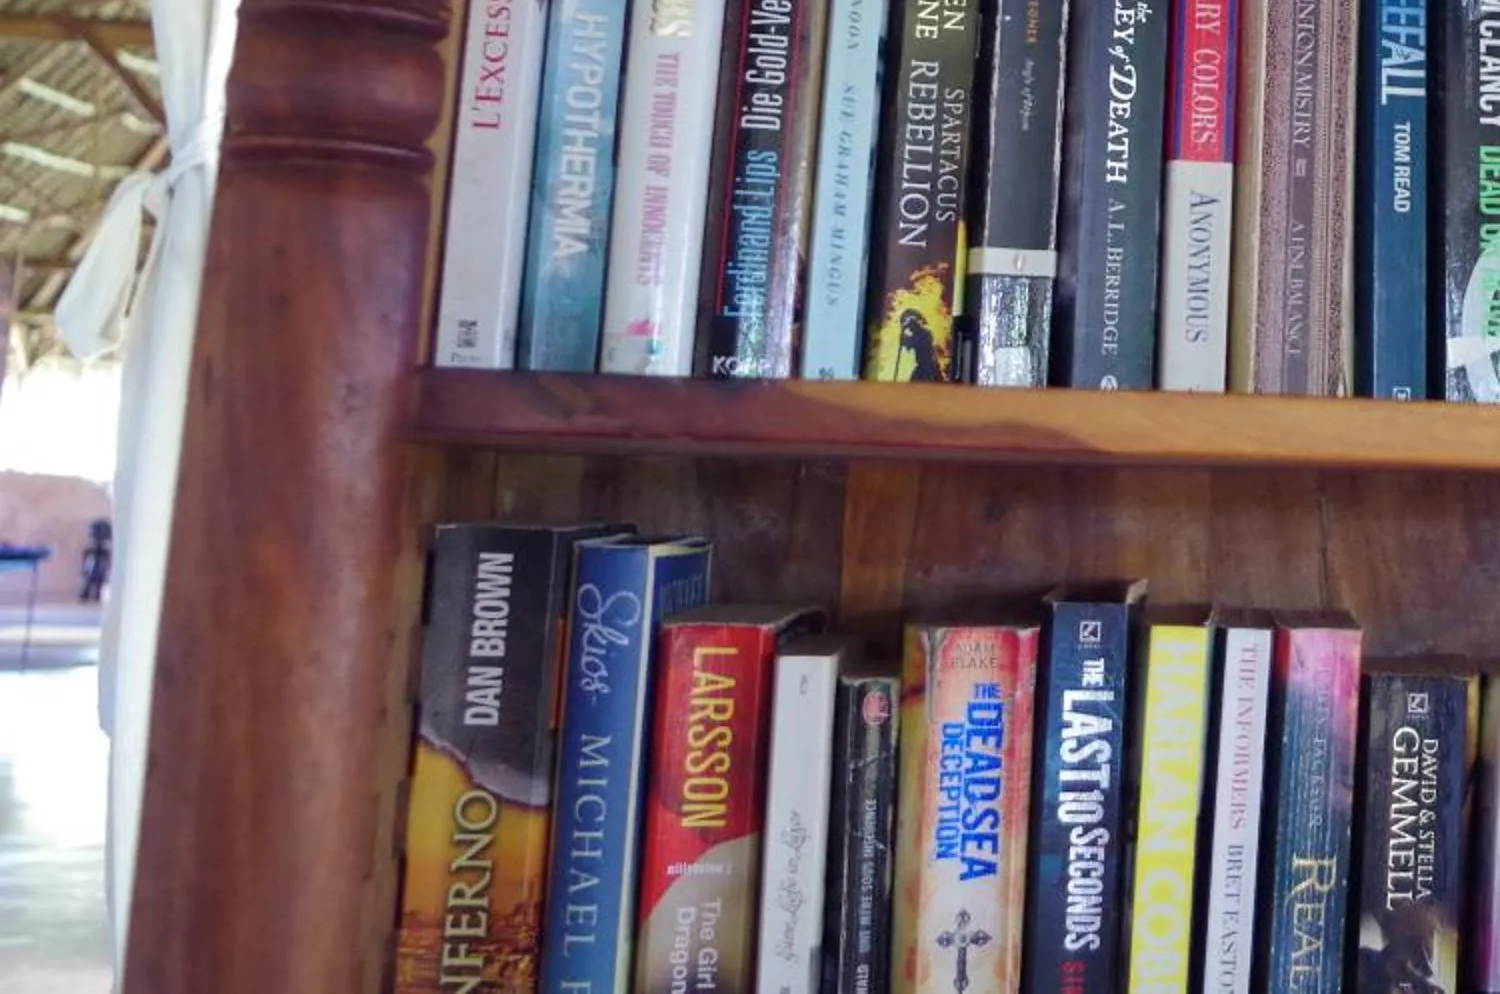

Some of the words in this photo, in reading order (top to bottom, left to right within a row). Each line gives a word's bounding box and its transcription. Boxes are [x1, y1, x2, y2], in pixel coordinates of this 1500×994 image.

[553, 9, 609, 258] HYPOTHERMIA
[741, 94, 783, 131] Die
[1105, 64, 1136, 183] DEATH
[1190, 49, 1220, 145] COLORS
[1292, 72, 1314, 147] MISTRY
[734, 150, 780, 202] Lips
[898, 59, 939, 248] REBELLION
[935, 88, 964, 222] SPARTACUS
[1394, 121, 1411, 163] TOM
[1394, 165, 1411, 213] READ
[724, 205, 773, 317] Ferdinand
[1185, 190, 1221, 344] ANONYMOUS
[469, 552, 514, 657] BROWN
[464, 666, 503, 725] DAN
[974, 684, 1001, 699] THE
[1082, 657, 1105, 687] THE
[1238, 644, 1257, 689] THE
[680, 646, 739, 828] LARSSON
[964, 702, 1003, 803] DEAD
[1059, 690, 1114, 788] LAST
[1145, 642, 1196, 851] HARLAN
[1230, 696, 1255, 829] INFORMERS
[1419, 739, 1438, 803] DAVID
[936, 722, 964, 859] DECEPTION
[1057, 791, 1104, 823] 10
[1386, 726, 1420, 911] GEMMELL
[1420, 809, 1436, 824] &
[563, 734, 612, 957] MICHAEL
[959, 806, 1000, 881] SEA
[1223, 844, 1244, 898] BRET
[1416, 829, 1435, 900] STELLA
[700, 898, 721, 940] The
[1064, 826, 1109, 951] SECONDS
[696, 948, 718, 990] Girl
[1220, 910, 1240, 994] EASTO
